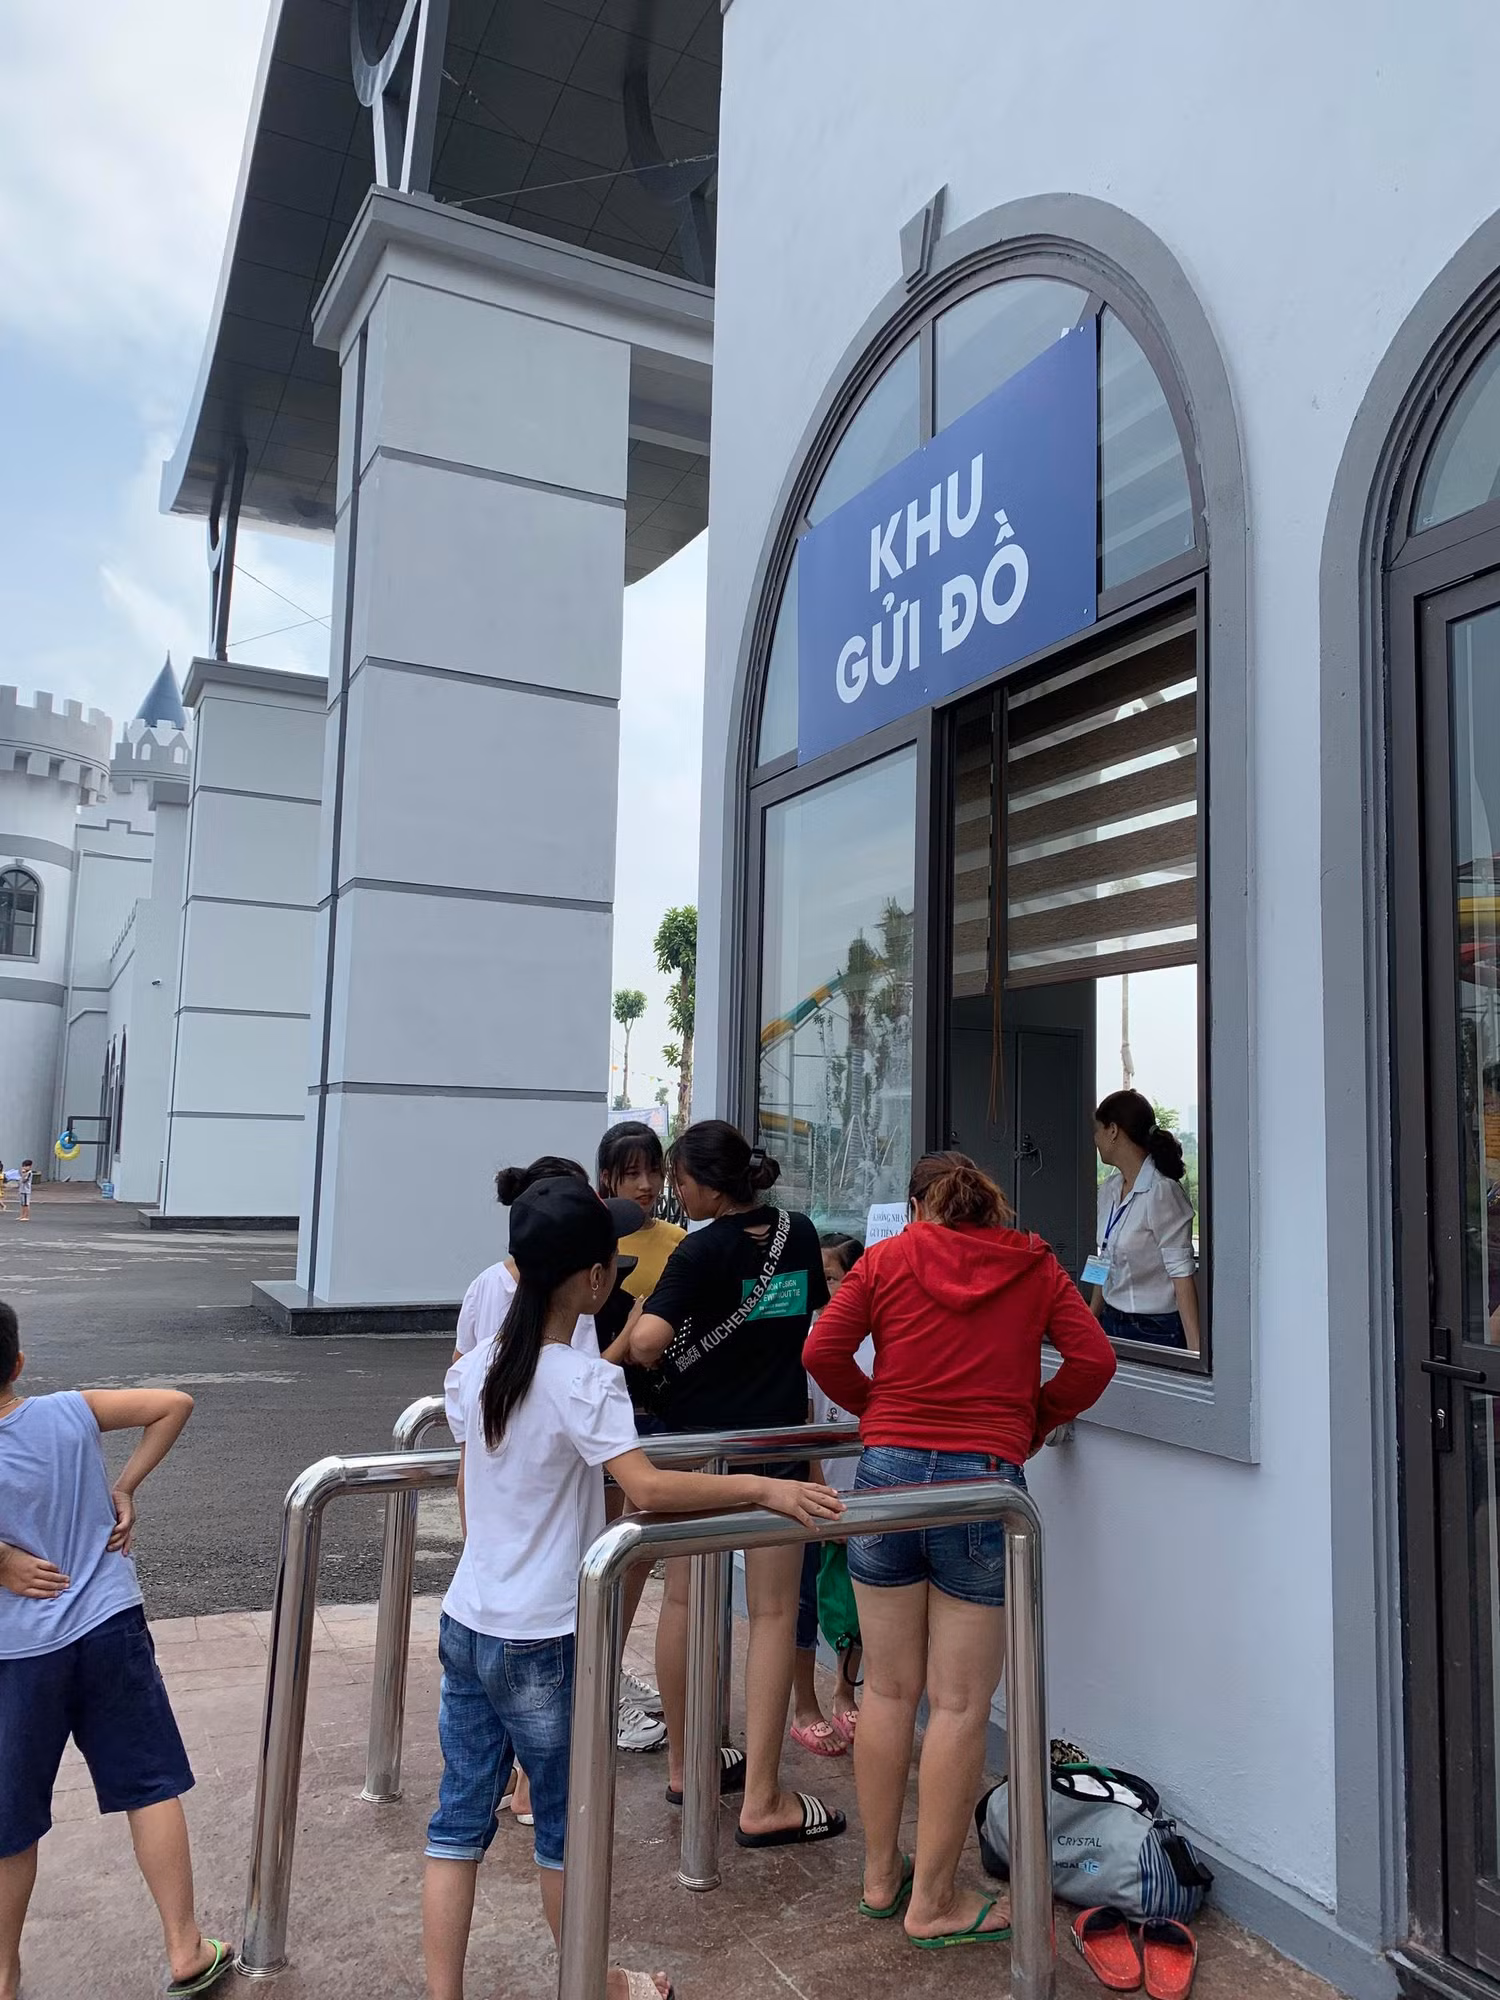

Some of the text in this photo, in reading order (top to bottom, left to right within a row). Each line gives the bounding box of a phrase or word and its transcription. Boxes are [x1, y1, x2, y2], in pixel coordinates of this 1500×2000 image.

[869, 452, 984, 593] KHU
[835, 508, 1029, 704] GỬI ĐỒ
[805, 1825, 829, 1836] adidas
